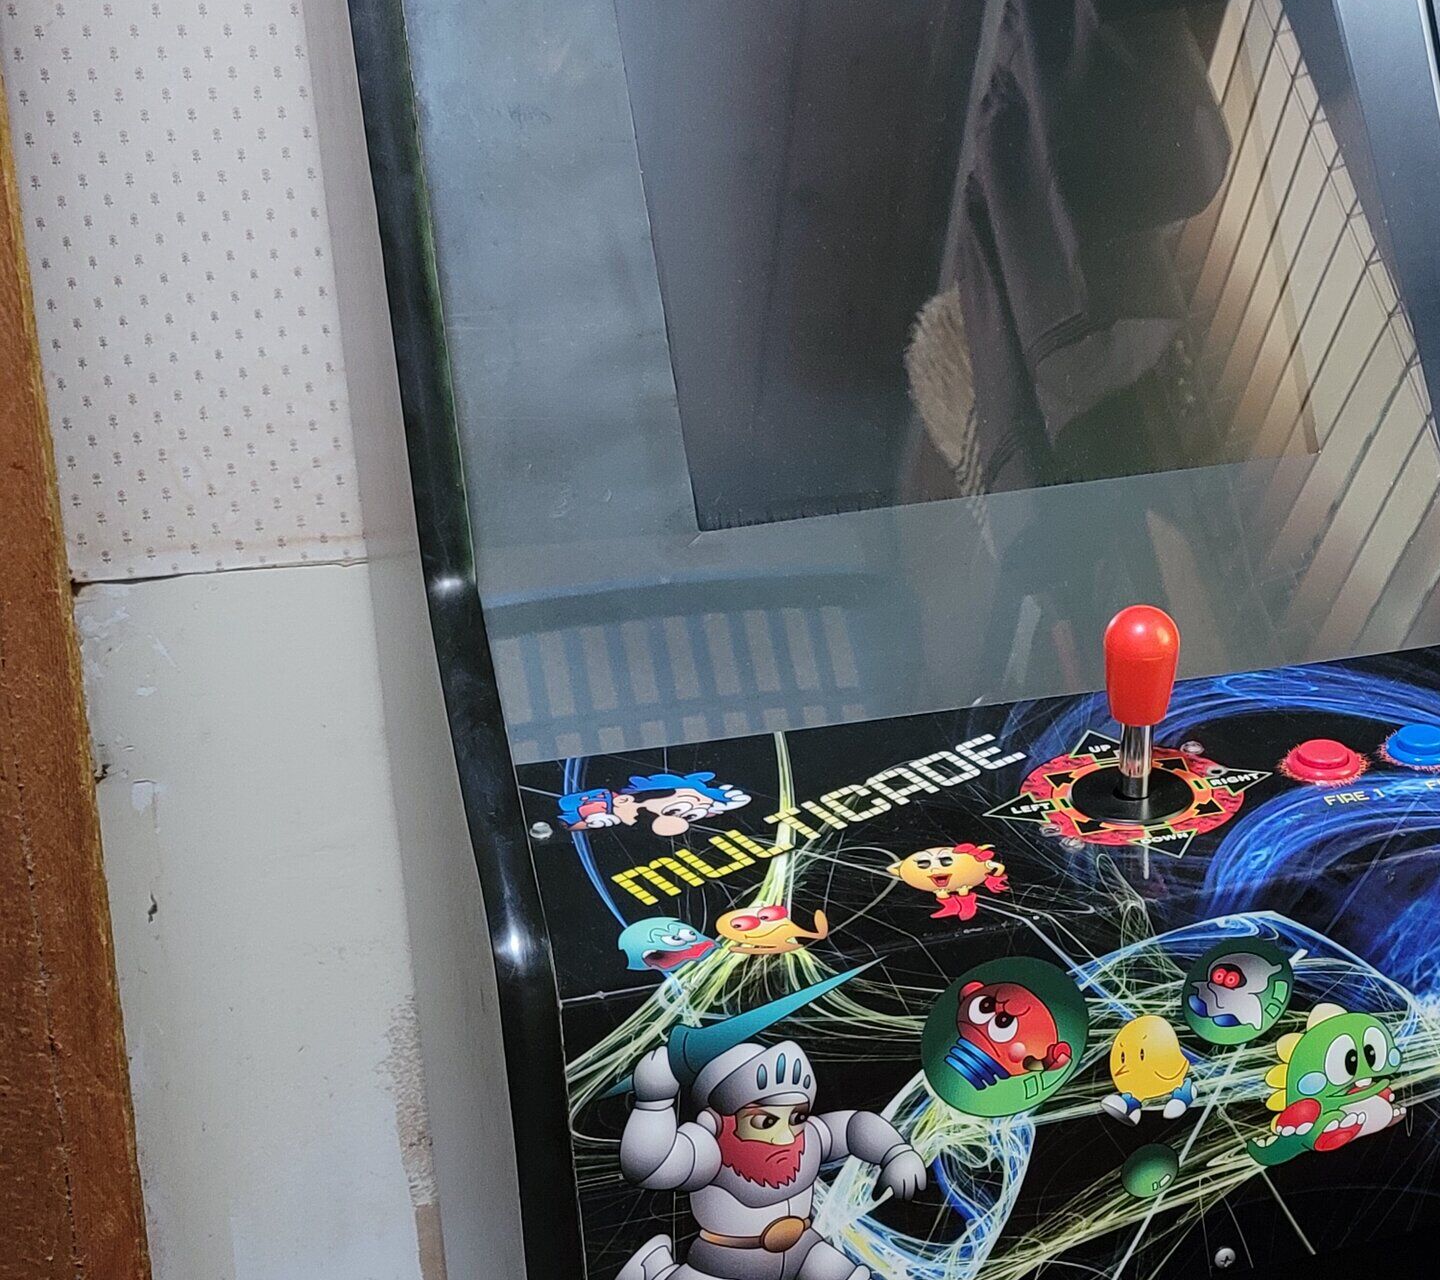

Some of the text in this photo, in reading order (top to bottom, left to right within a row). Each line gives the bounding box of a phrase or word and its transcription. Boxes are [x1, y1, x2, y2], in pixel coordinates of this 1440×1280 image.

[1088, 743, 1112, 755] UP
[1209, 772, 1261, 787] RIGHT
[1323, 788, 1385, 806] FIRE 1
[1010, 801, 1051, 815] LEFT
[610, 733, 1027, 906] MULTICADE
[1140, 831, 1189, 845] DOWN
